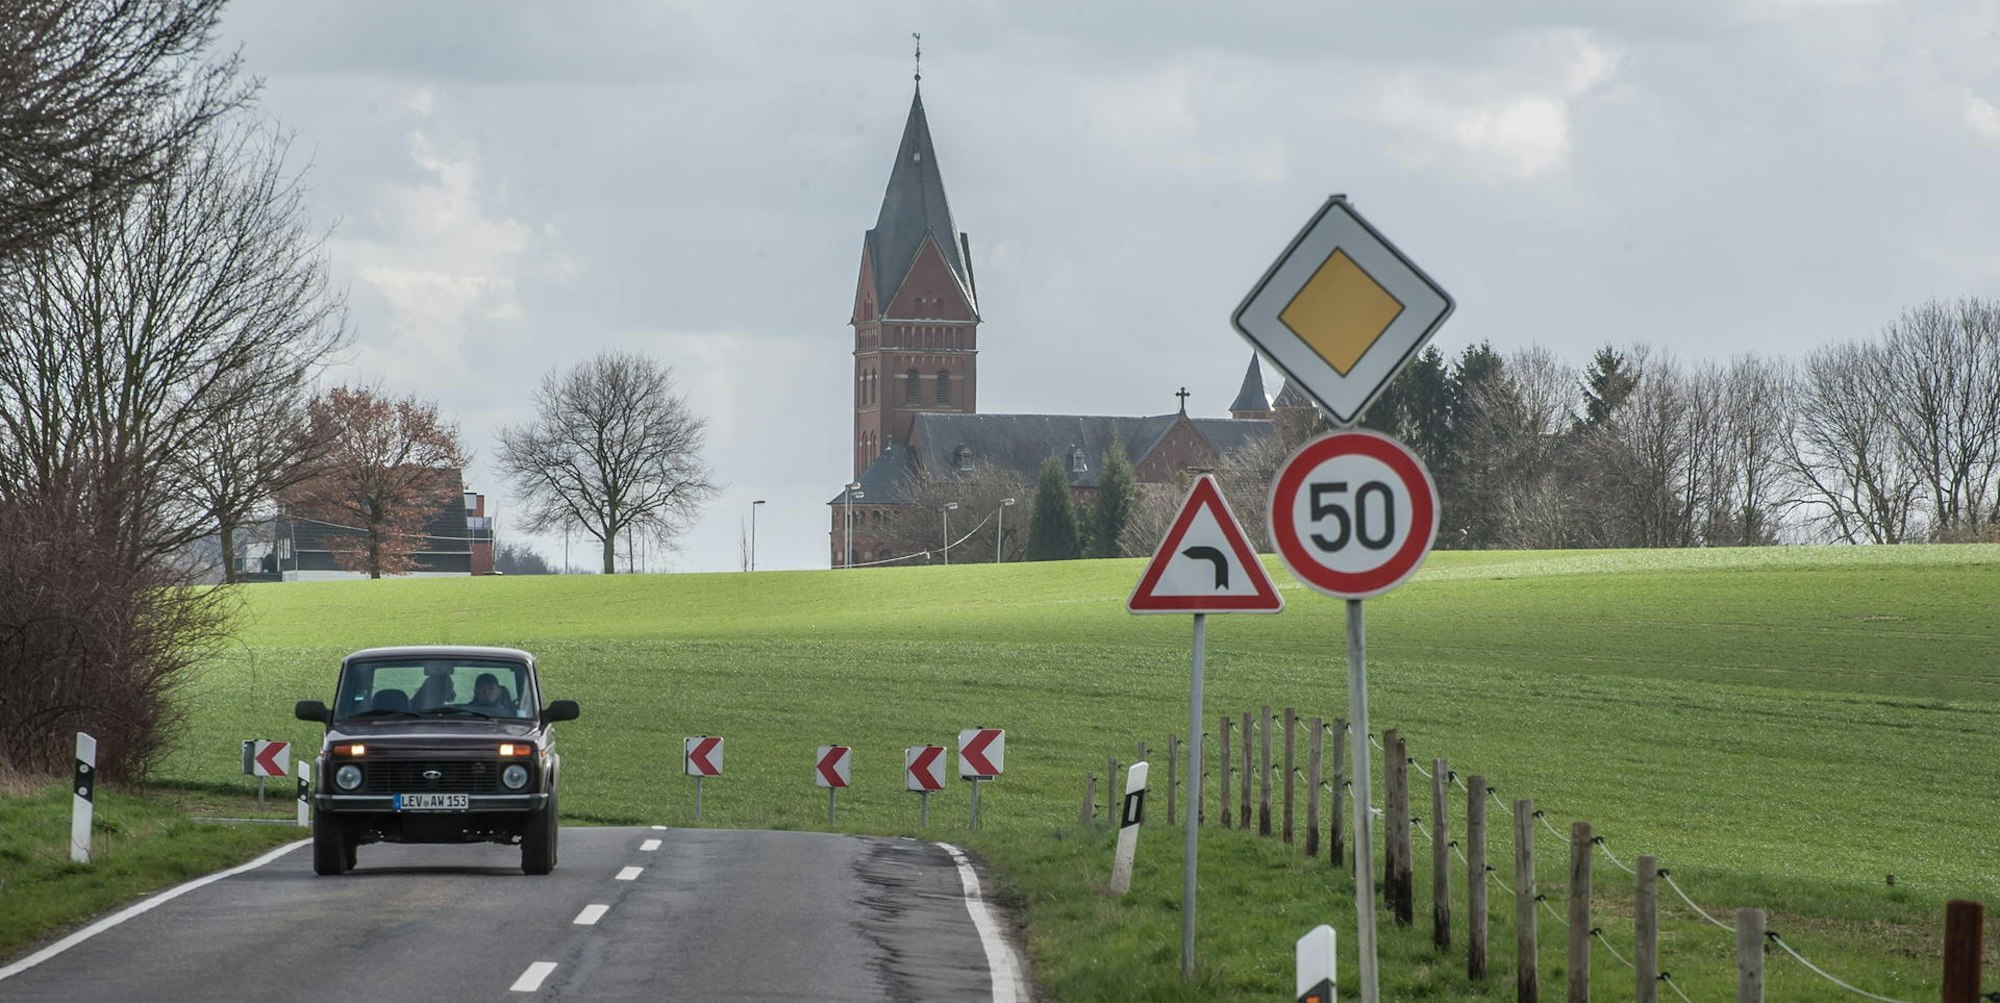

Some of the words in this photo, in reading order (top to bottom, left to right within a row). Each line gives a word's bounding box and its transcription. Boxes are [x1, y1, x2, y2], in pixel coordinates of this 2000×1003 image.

[1310, 480, 1395, 553] 50
[401, 795, 423, 807] LEV
[430, 795, 445, 807] AW
[446, 795, 467, 807] 153
